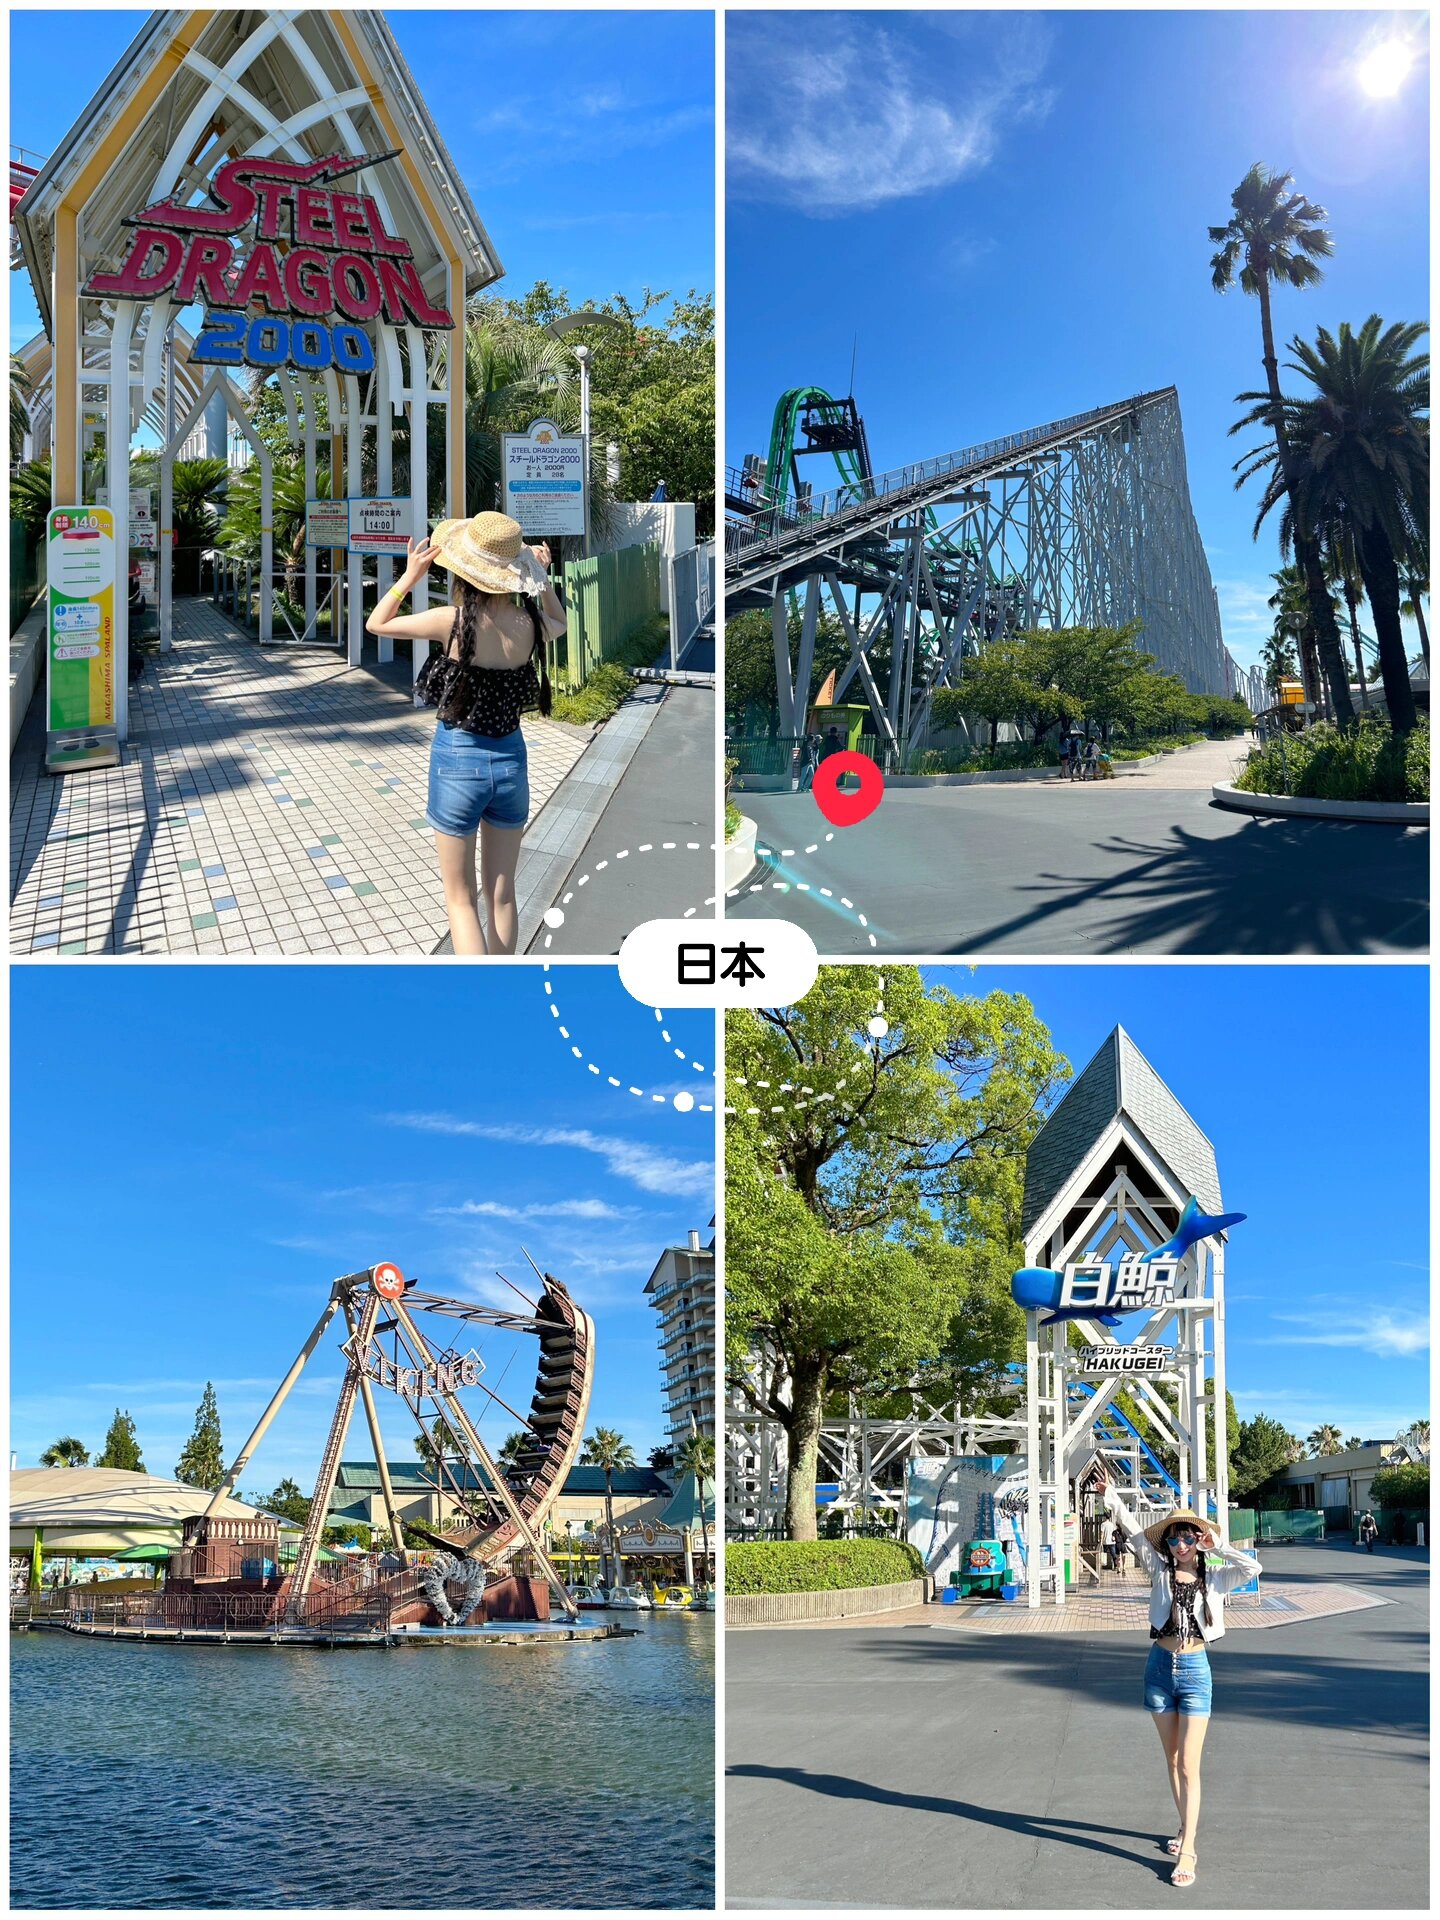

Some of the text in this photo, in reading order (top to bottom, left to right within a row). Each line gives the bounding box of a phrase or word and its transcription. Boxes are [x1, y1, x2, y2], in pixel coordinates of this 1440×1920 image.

[122, 149, 414, 259] STEEL
[81, 227, 455, 329] DRAGON
[187, 312, 376, 375] 2000
[509, 455, 580, 464] スチールドラゴン2000
[72, 515, 110, 529] 140cm
[359, 509, 401, 517] 点検時間のご案内
[369, 521, 391, 530] 14:00
[104, 616, 112, 720] NAGASHIMA SPALAND
[1059, 1250, 1179, 1309] 白鯨
[1080, 1346, 1173, 1356] ハイブリッドコースター
[1085, 1357, 1164, 1371] HAKUGEI
[355, 1343, 479, 1397] VIKING
